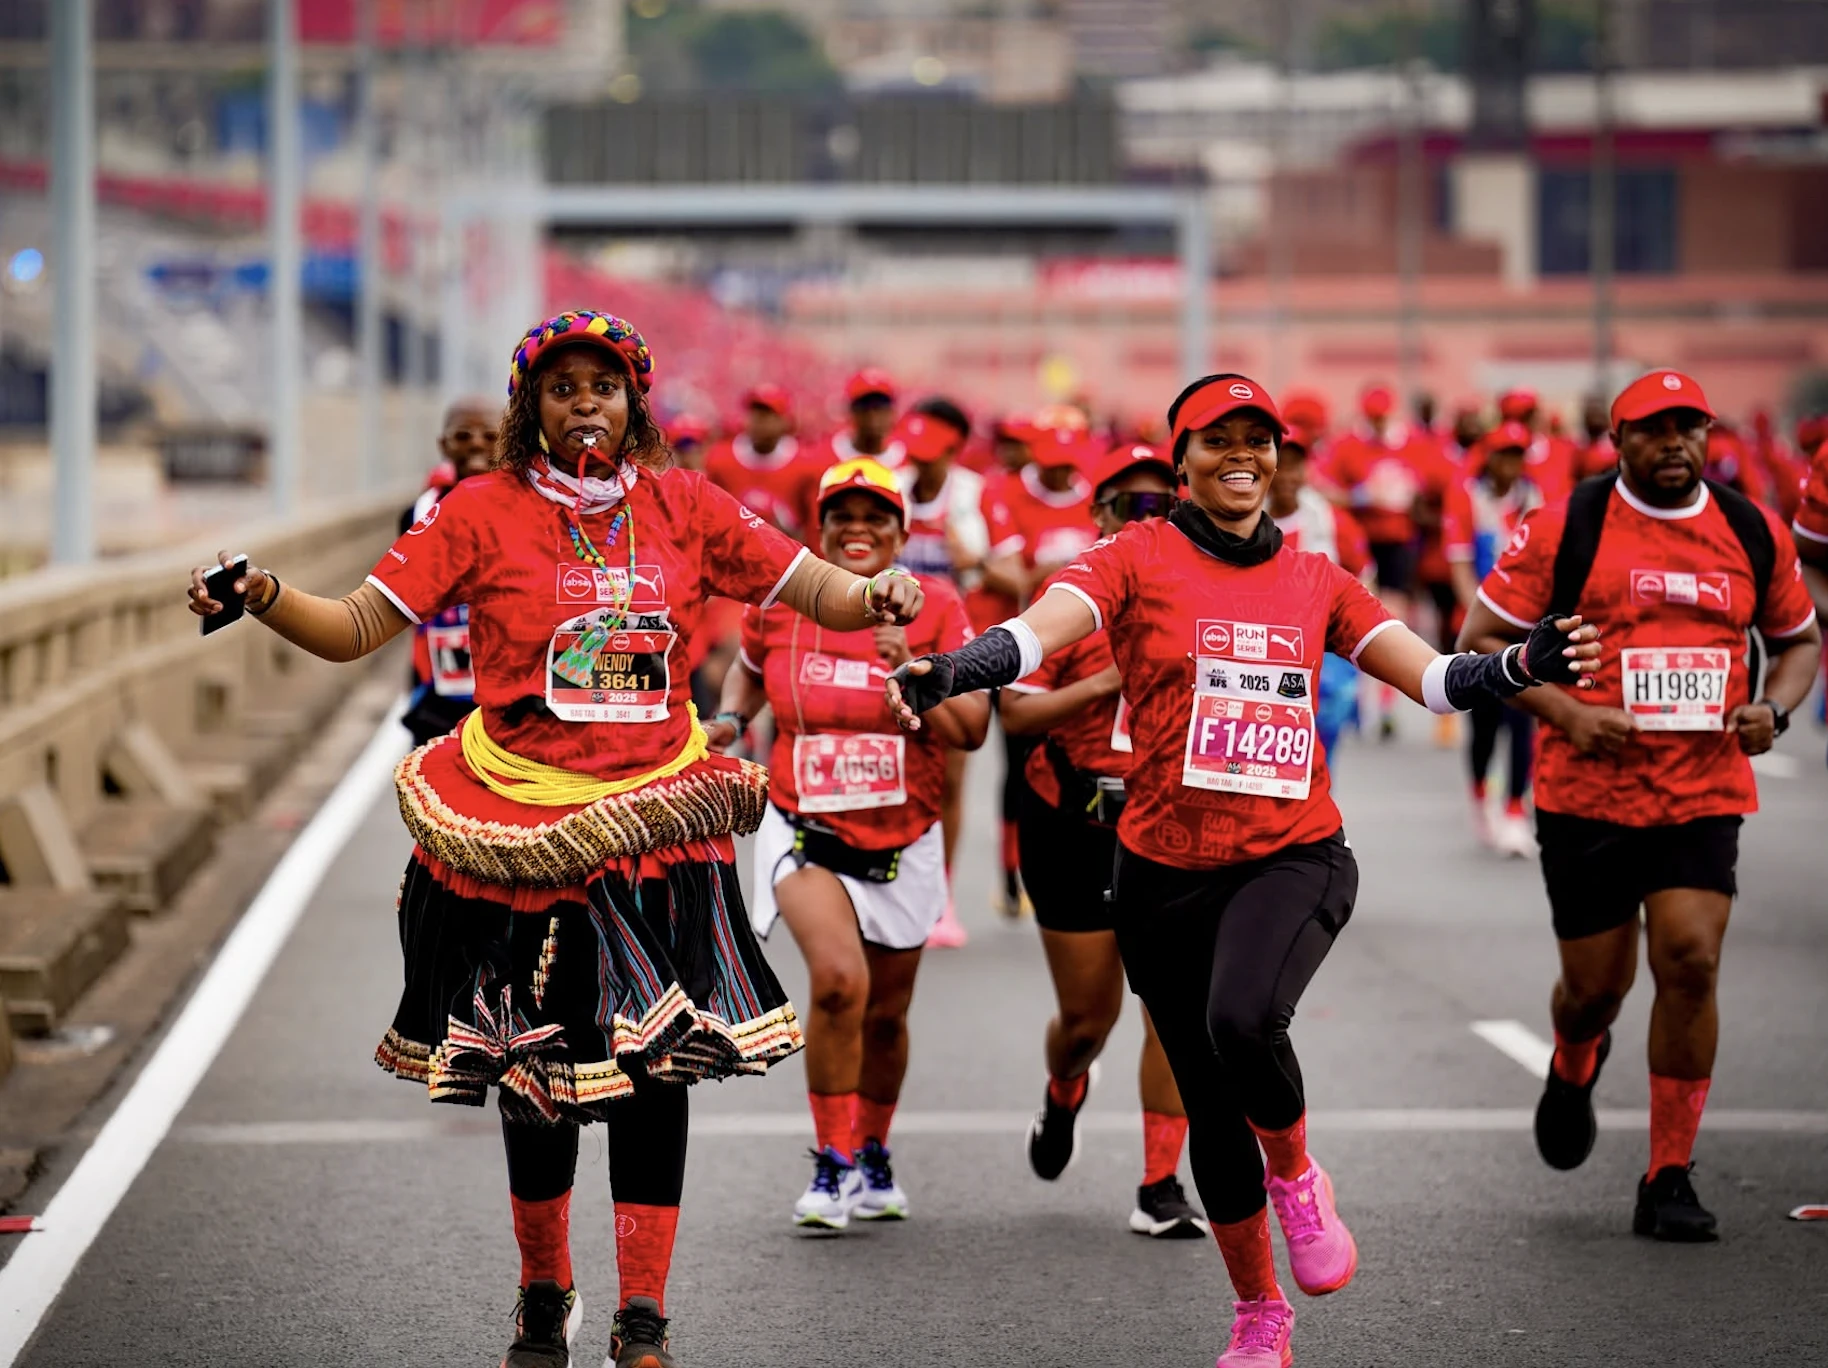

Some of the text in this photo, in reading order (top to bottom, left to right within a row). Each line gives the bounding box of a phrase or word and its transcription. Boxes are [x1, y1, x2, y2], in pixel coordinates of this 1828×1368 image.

[566, 577, 590, 587] absa
[1205, 632, 1228, 642] absa
[1236, 628, 1265, 640] RUN
[1236, 644, 1264, 653] SERIES
[599, 673, 651, 690] 3641
[1209, 677, 1228, 689] AFS
[1239, 673, 1271, 692] 2025
[1281, 673, 1305, 690] ASA
[1635, 671, 1723, 702] H19831
[608, 692, 638, 703] 2025
[1246, 764, 1278, 778] 2025
